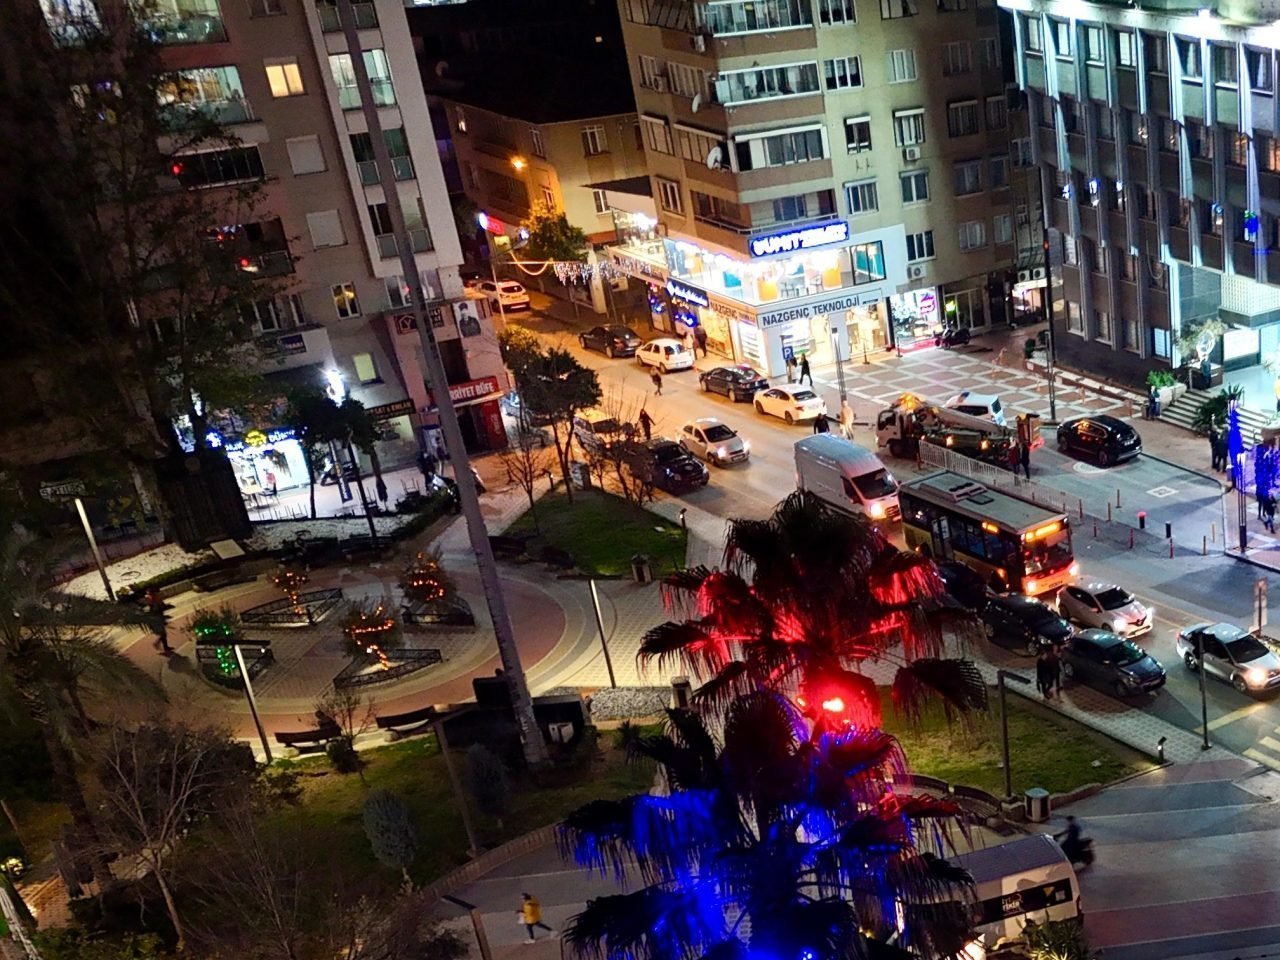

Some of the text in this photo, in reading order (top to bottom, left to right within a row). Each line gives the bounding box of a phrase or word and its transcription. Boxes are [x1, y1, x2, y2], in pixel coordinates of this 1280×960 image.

[762, 307, 810, 326] NAZGENÇ
[813, 296, 860, 315] TEKNOLOJİ
[449, 385, 474, 400] RRİYET
